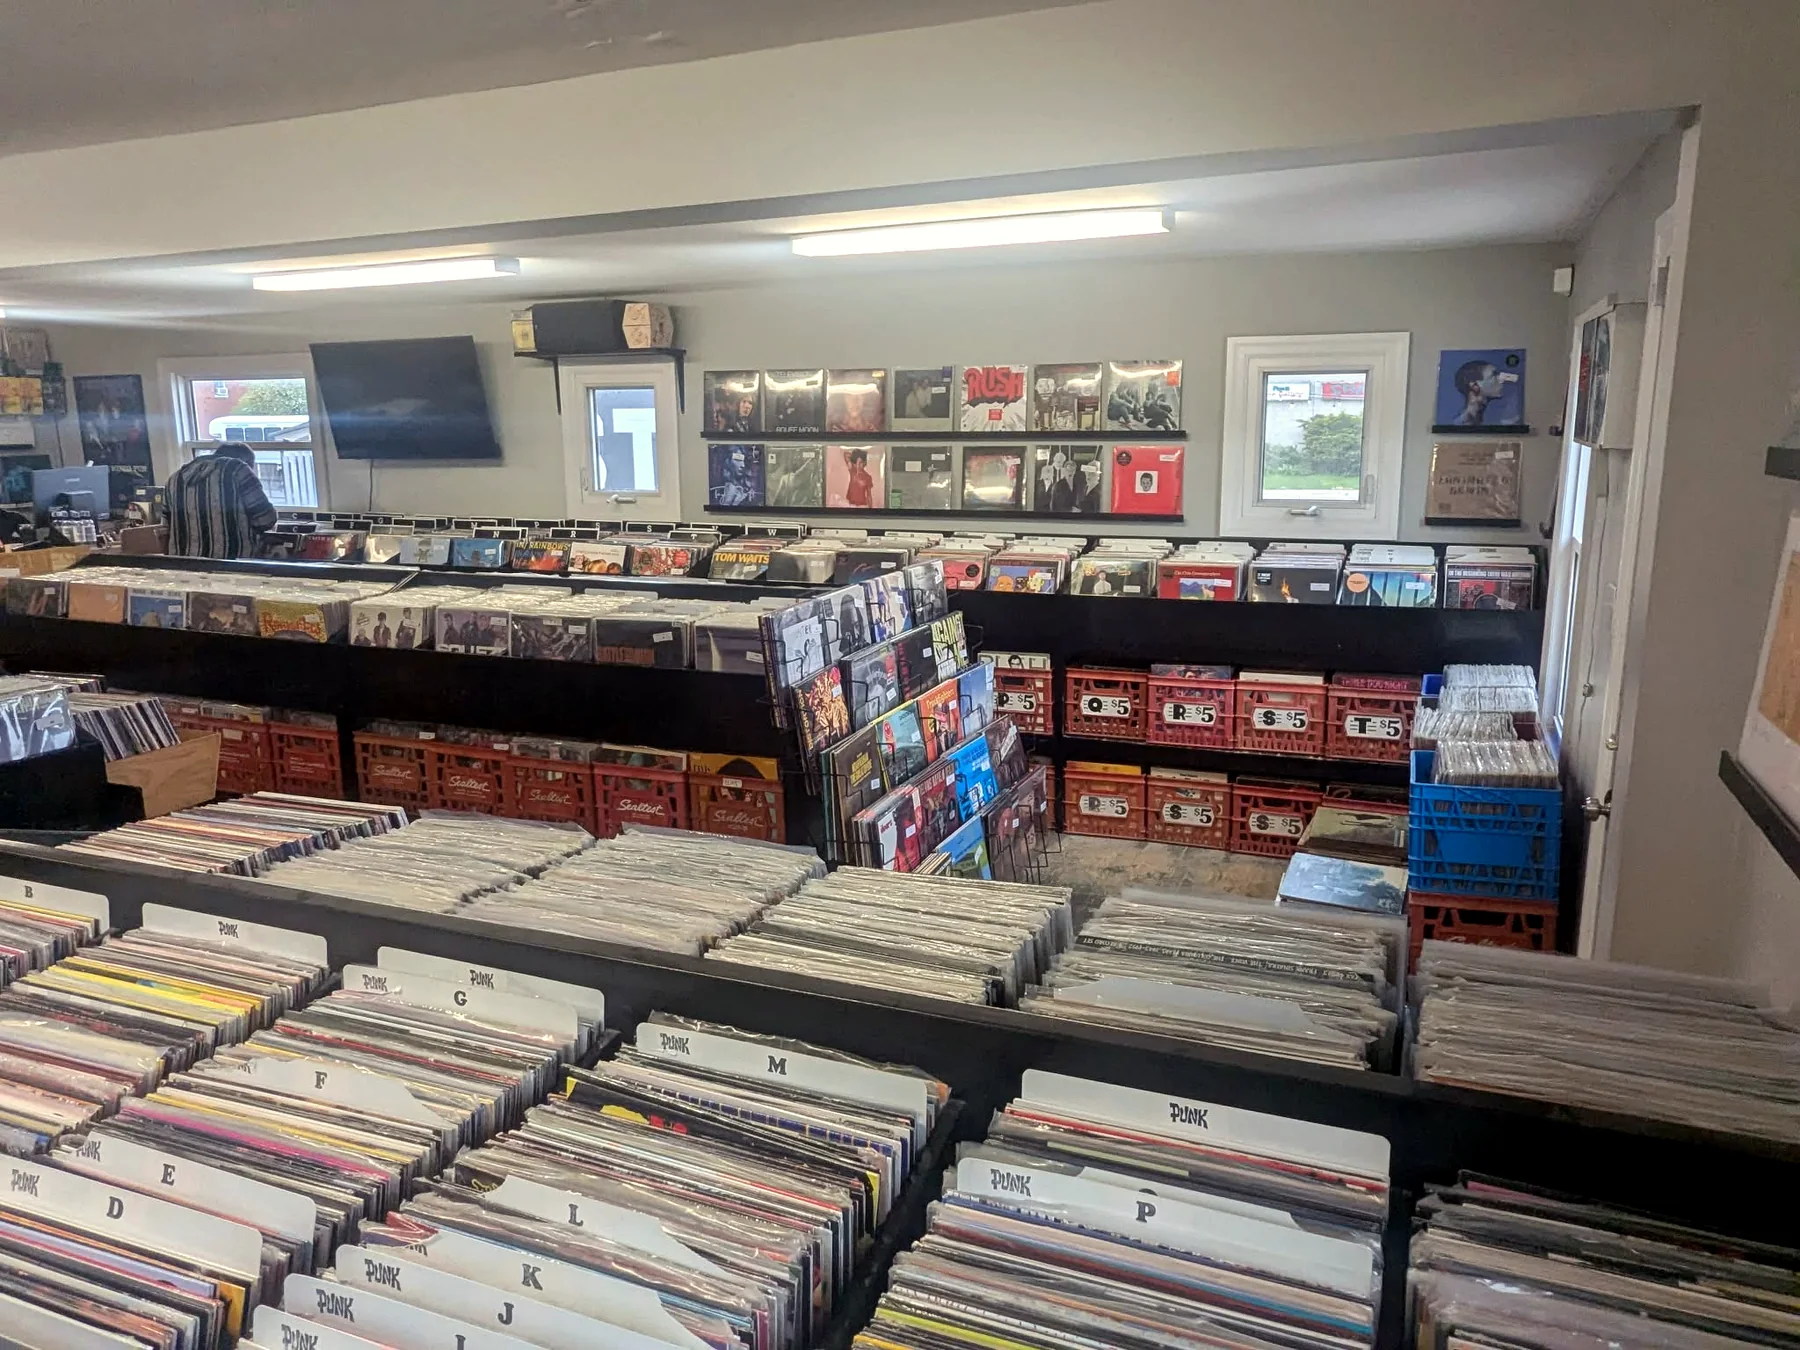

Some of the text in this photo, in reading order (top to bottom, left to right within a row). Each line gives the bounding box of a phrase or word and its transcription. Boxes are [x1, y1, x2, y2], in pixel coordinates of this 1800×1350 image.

[963, 366, 1025, 403] RUSH
[529, 541, 569, 551] RAINBOWS
[714, 552, 770, 565] TOM WAITS
[998, 692, 1035, 710] P $5
[1088, 697, 1129, 715] Q $5
[1173, 704, 1214, 723] R $5
[1263, 710, 1306, 729] S $5
[1354, 717, 1401, 736] T $5
[617, 799, 666, 816] Sealtest
[1109, 798, 1127, 815] $5
[1169, 804, 1212, 824] S $5
[1256, 814, 1301, 835] S $5
[24, 886, 33, 898] B
[218, 920, 239, 938] PUNK
[362, 974, 389, 993] PUNK
[469, 969, 495, 990] PUNK
[454, 990, 468, 1007] G
[660, 1032, 690, 1055] PUNK
[767, 1055, 788, 1076] M
[314, 1072, 328, 1090] F
[1169, 1101, 1208, 1130] PUNK
[11, 1169, 41, 1197] PUNK
[160, 1163, 176, 1186] E
[990, 1168, 1032, 1197] PUNK
[106, 1196, 124, 1220] D
[568, 1203, 584, 1227] L
[1136, 1200, 1157, 1223] P
[364, 1258, 402, 1291] PUNK
[521, 1263, 544, 1291] K
[315, 1288, 355, 1323] PUNK
[497, 1301, 515, 1325] J
